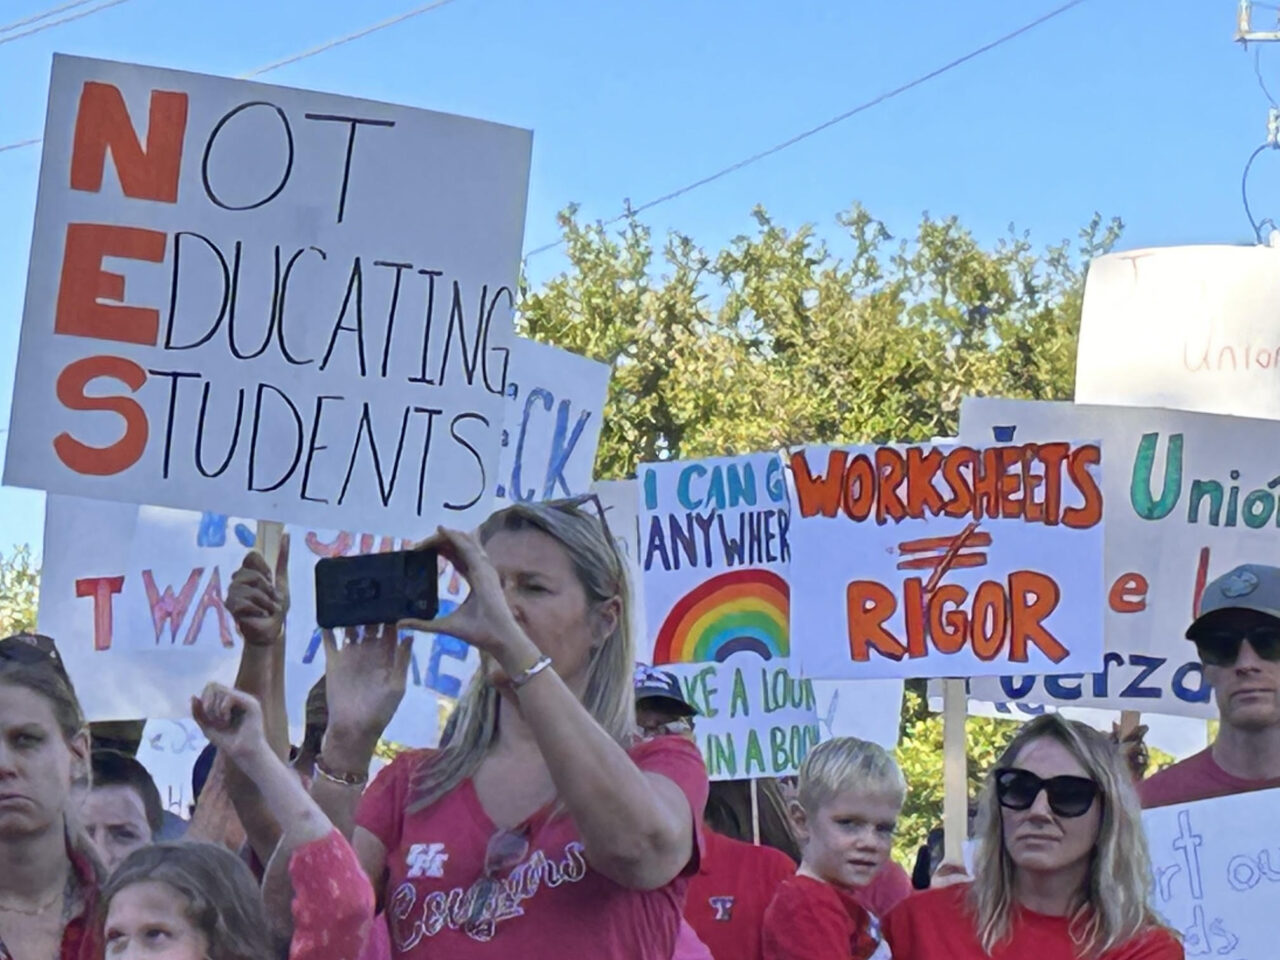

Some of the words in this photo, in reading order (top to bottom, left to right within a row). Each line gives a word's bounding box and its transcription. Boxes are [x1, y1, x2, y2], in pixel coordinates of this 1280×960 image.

[71, 81, 396, 223] NOT
[54, 222, 517, 398] EDUCATING
[53, 355, 490, 516] STUDENTS
[495, 387, 593, 500] CK
[677, 462, 757, 511] CAN
[792, 442, 1104, 530] WORKSHEETS
[847, 570, 1070, 662] RIGOR
[730, 668, 749, 718] A
[966, 652, 1213, 705] uerza
[705, 731, 737, 777] IN
[745, 729, 765, 774] A
[771, 725, 820, 773] BOO
